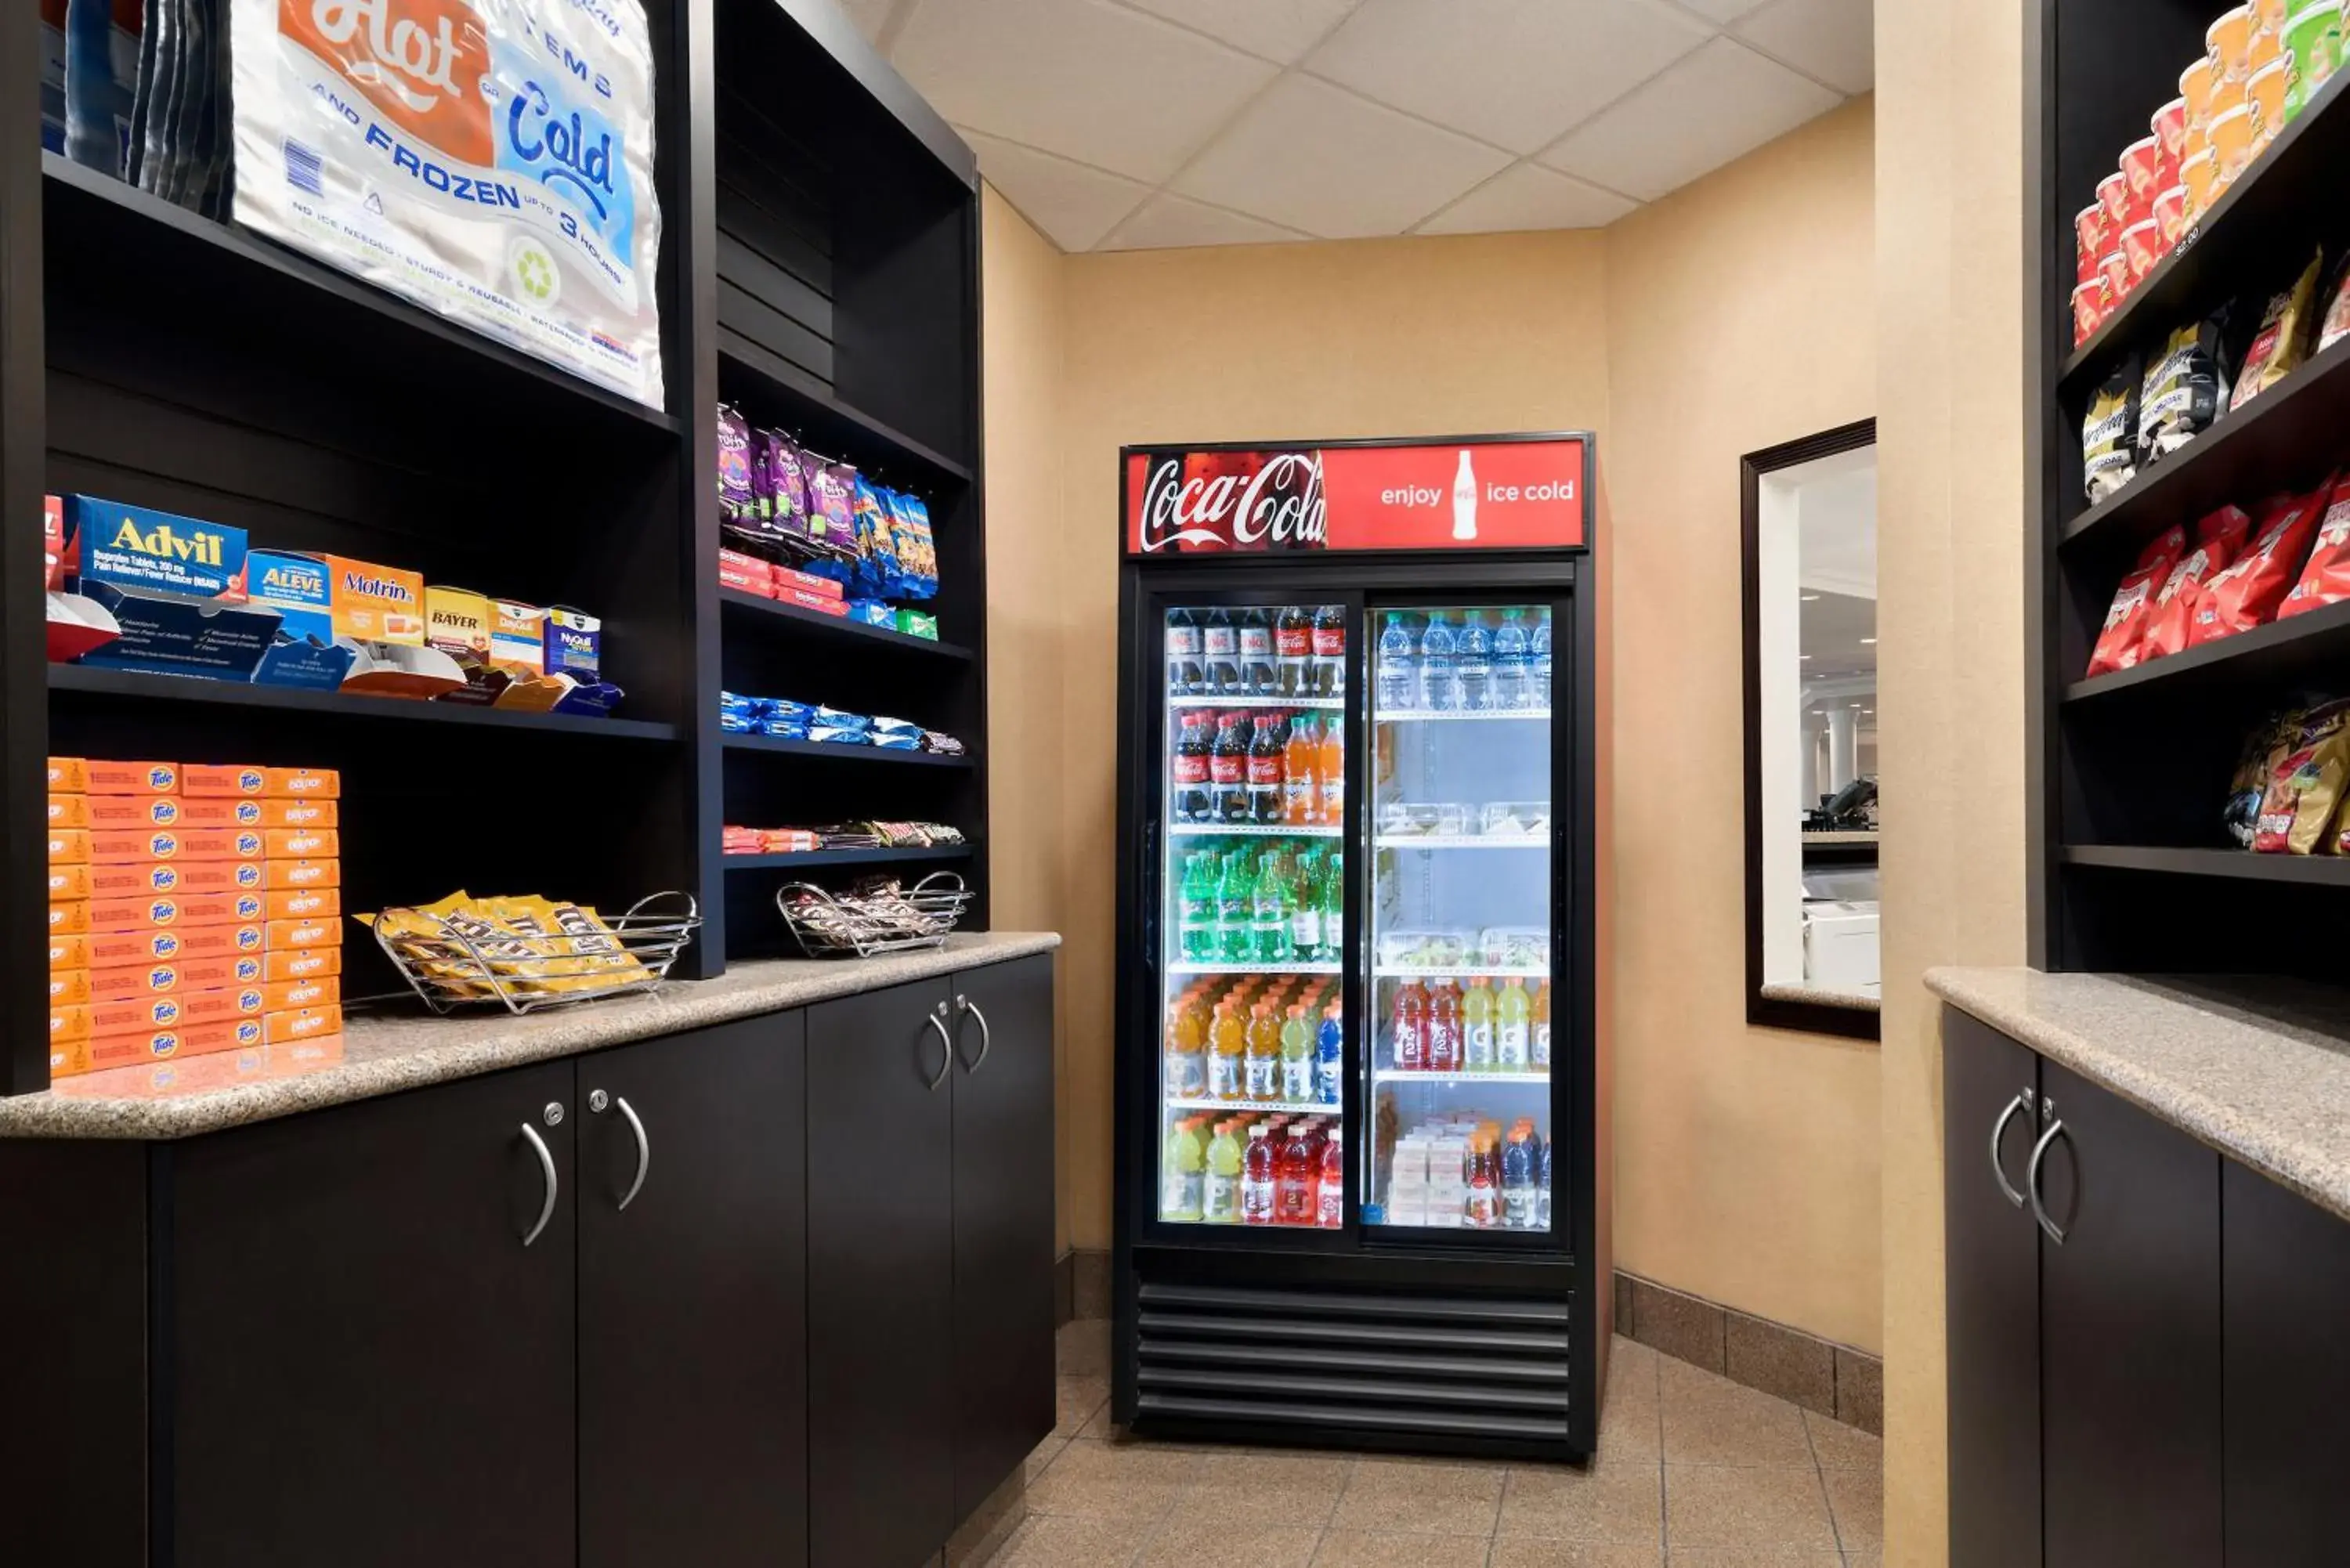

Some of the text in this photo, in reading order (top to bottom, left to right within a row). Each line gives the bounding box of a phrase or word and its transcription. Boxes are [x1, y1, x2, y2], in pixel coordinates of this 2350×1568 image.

[482, 82, 500, 97] OR
[508, 81, 613, 195] Cold
[313, 83, 360, 125] AND
[365, 123, 521, 209] FROZEN
[559, 211, 577, 238] 3
[580, 234, 622, 284] HOURS
[1381, 484, 1442, 508] enjoy
[1487, 482, 1520, 501] ice
[1524, 479, 1574, 501] cold
[1141, 453, 1326, 551] Coca-Cola
[110, 517, 222, 565] Advil
[262, 568, 324, 593] ALEVE
[344, 572, 406, 601] Motrin
[432, 611, 478, 629] BAYER
[150, 771, 173, 787] Tide
[240, 775, 260, 789] Tide
[154, 805, 175, 820] Tide
[237, 806, 258, 820] Tide
[153, 839, 175, 854] Tide
[238, 837, 258, 851] Tide
[152, 872, 174, 887] Tide
[237, 869, 257, 883] Tide
[152, 905, 174, 919] Tide
[238, 900, 258, 914] Tide
[238, 931, 257, 946] Tide
[154, 939, 175, 954] Tide
[237, 963, 256, 977] Tide
[151, 972, 174, 987] Tide
[240, 995, 260, 1009] Tide
[154, 1006, 176, 1021] Tide
[238, 1026, 257, 1040] Tide
[153, 1039, 174, 1053] Tide
